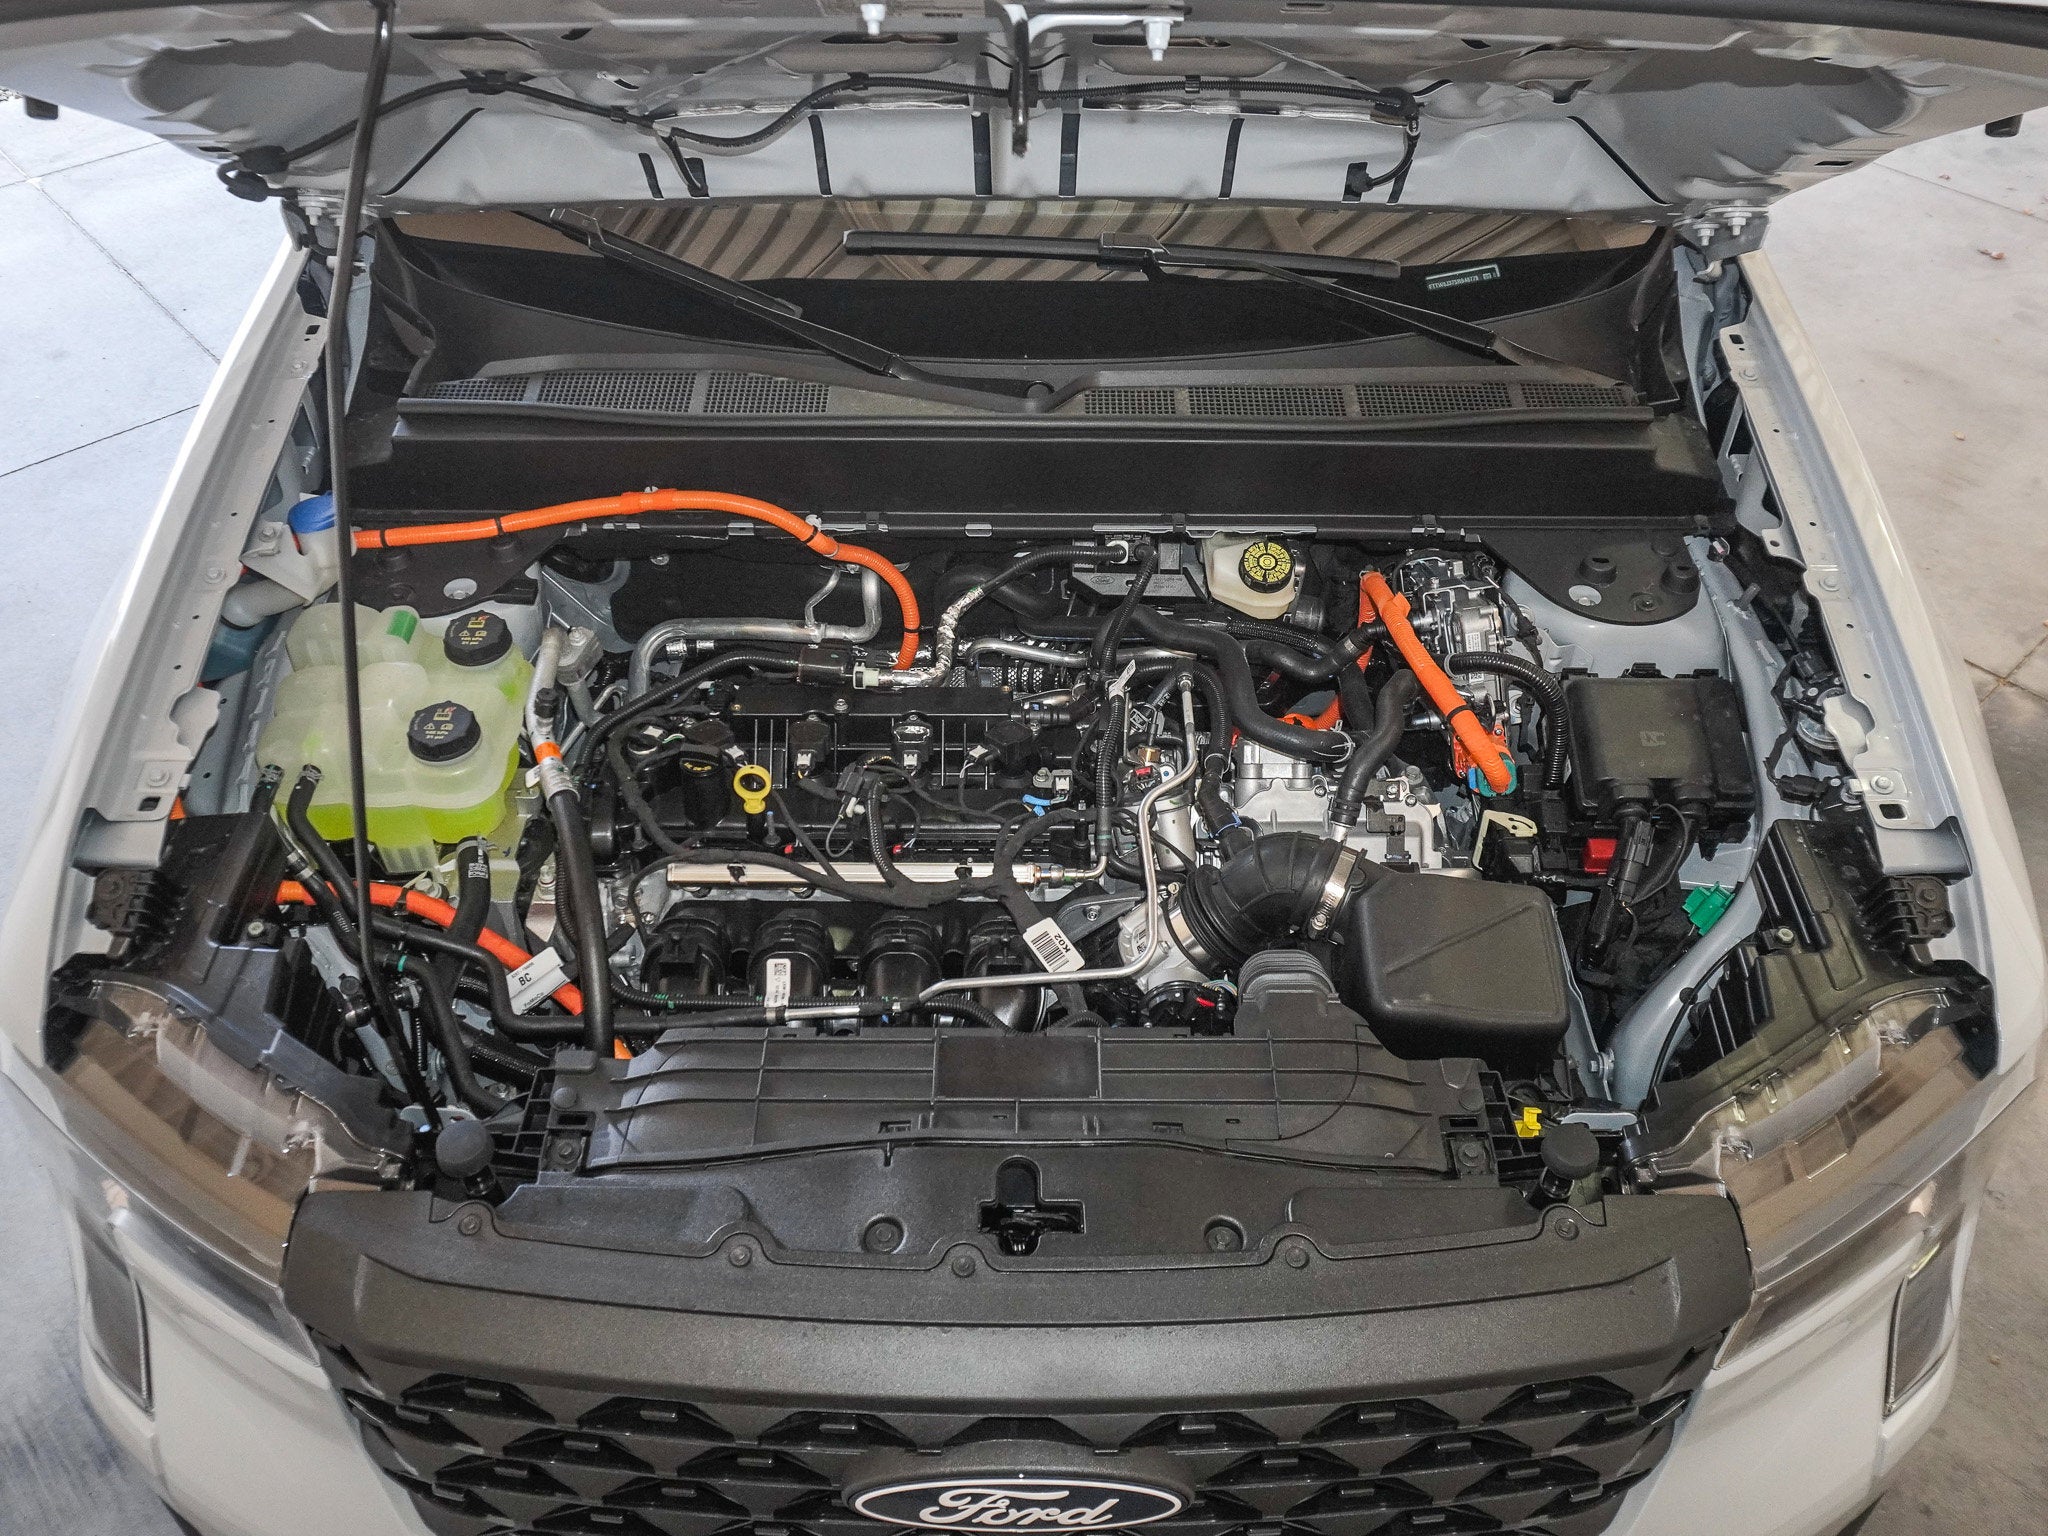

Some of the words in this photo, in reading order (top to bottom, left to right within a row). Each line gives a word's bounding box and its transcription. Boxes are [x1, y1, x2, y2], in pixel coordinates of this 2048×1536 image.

[1054, 933, 1071, 953] K02
[518, 972, 532, 986] BC
[919, 1488, 1120, 1526] Ford
